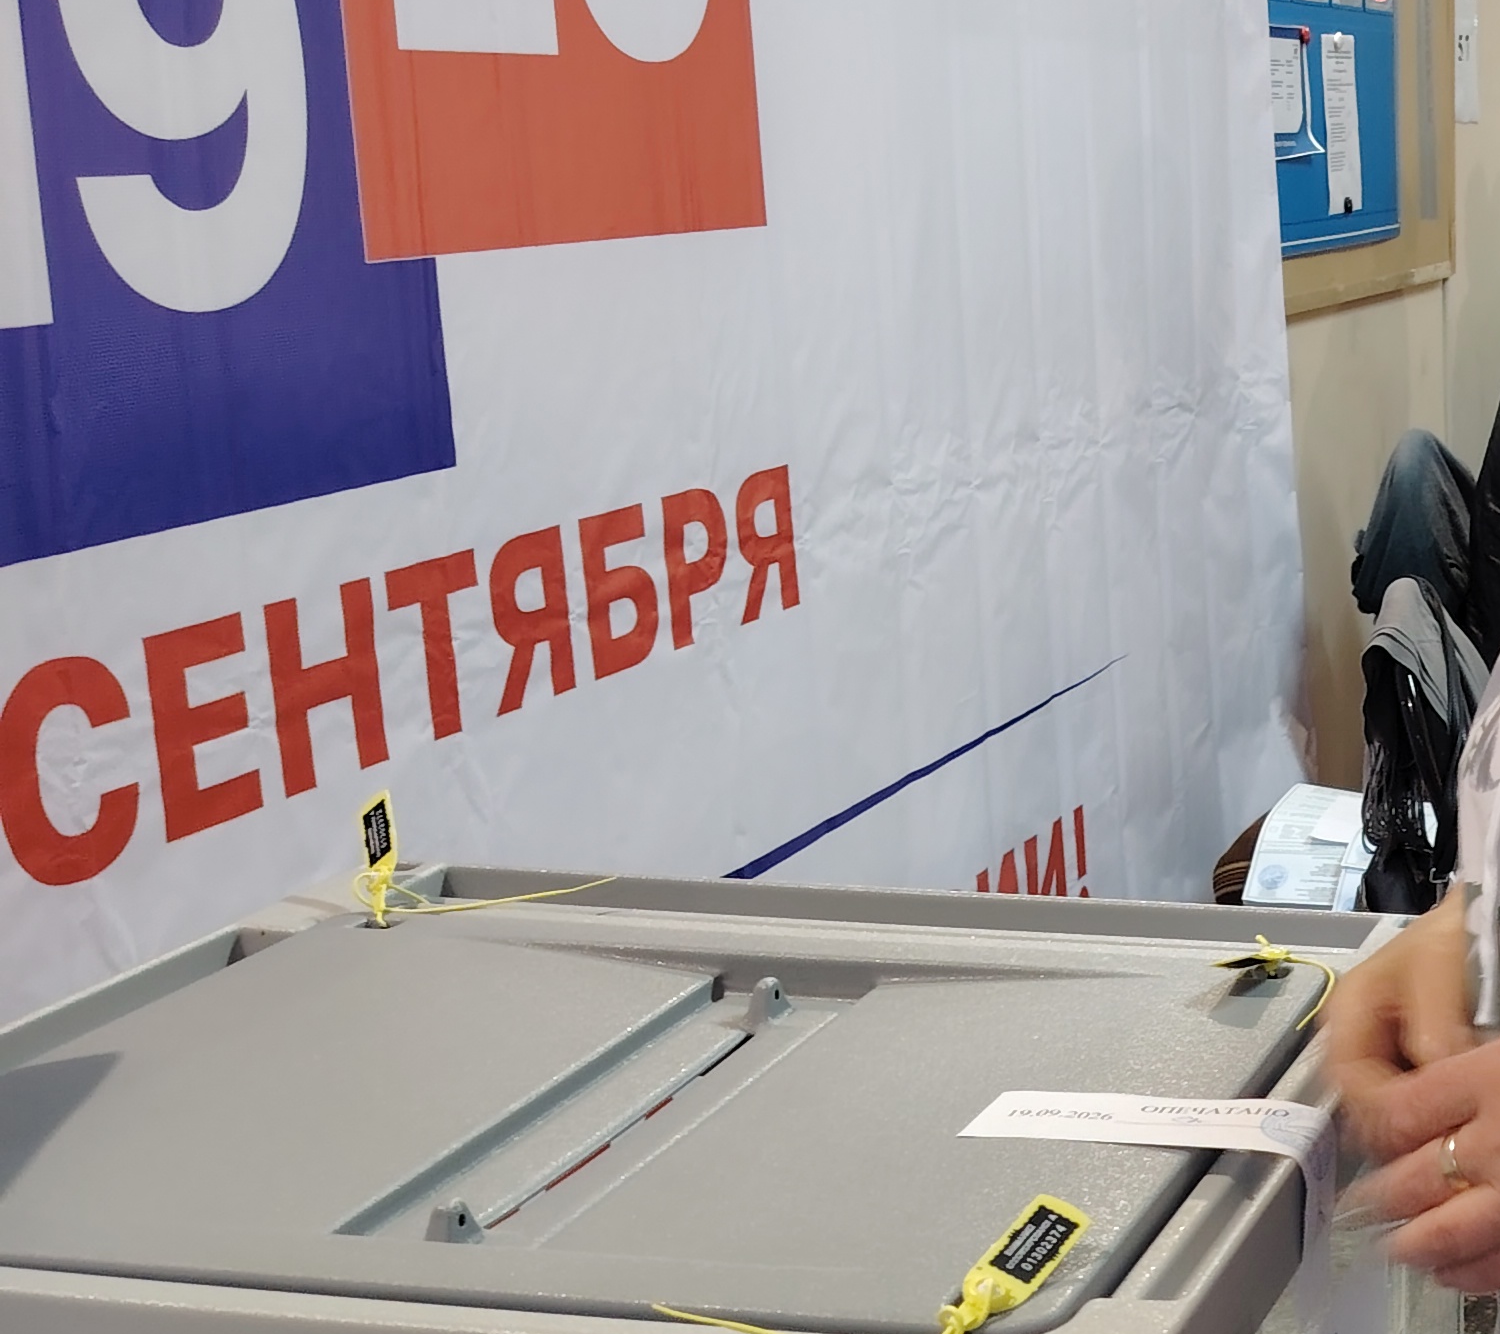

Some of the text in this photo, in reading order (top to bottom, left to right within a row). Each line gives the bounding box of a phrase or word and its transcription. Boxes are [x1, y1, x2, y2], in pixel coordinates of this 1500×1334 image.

[0, 464, 800, 886] СЕНТЯБРЯ
[1007, 1104, 1290, 1121] 19.09.2026 ОПЕЧАТАНО
